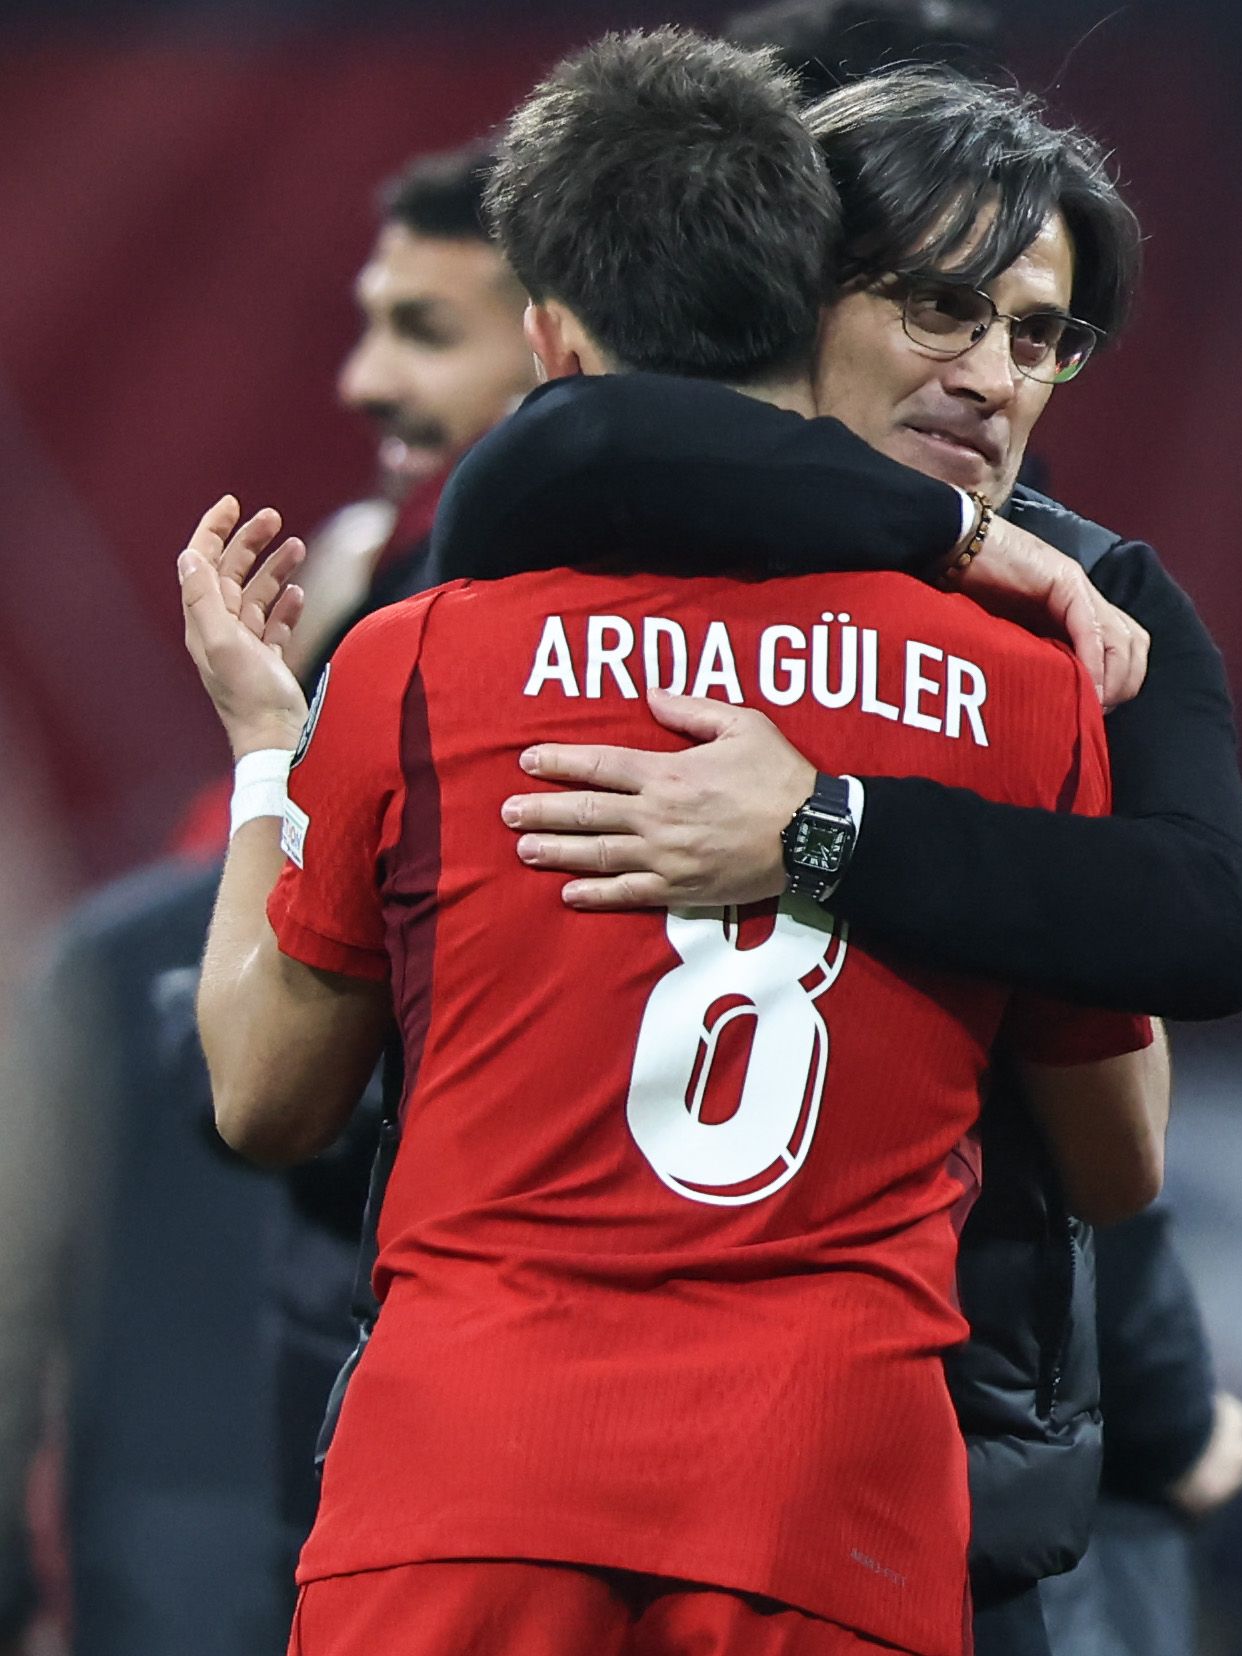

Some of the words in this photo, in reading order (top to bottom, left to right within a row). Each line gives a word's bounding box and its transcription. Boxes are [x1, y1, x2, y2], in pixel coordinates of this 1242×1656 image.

[523, 616, 744, 704] ARDA
[759, 611, 990, 748] GÜLER
[626, 900, 849, 1208] 8
